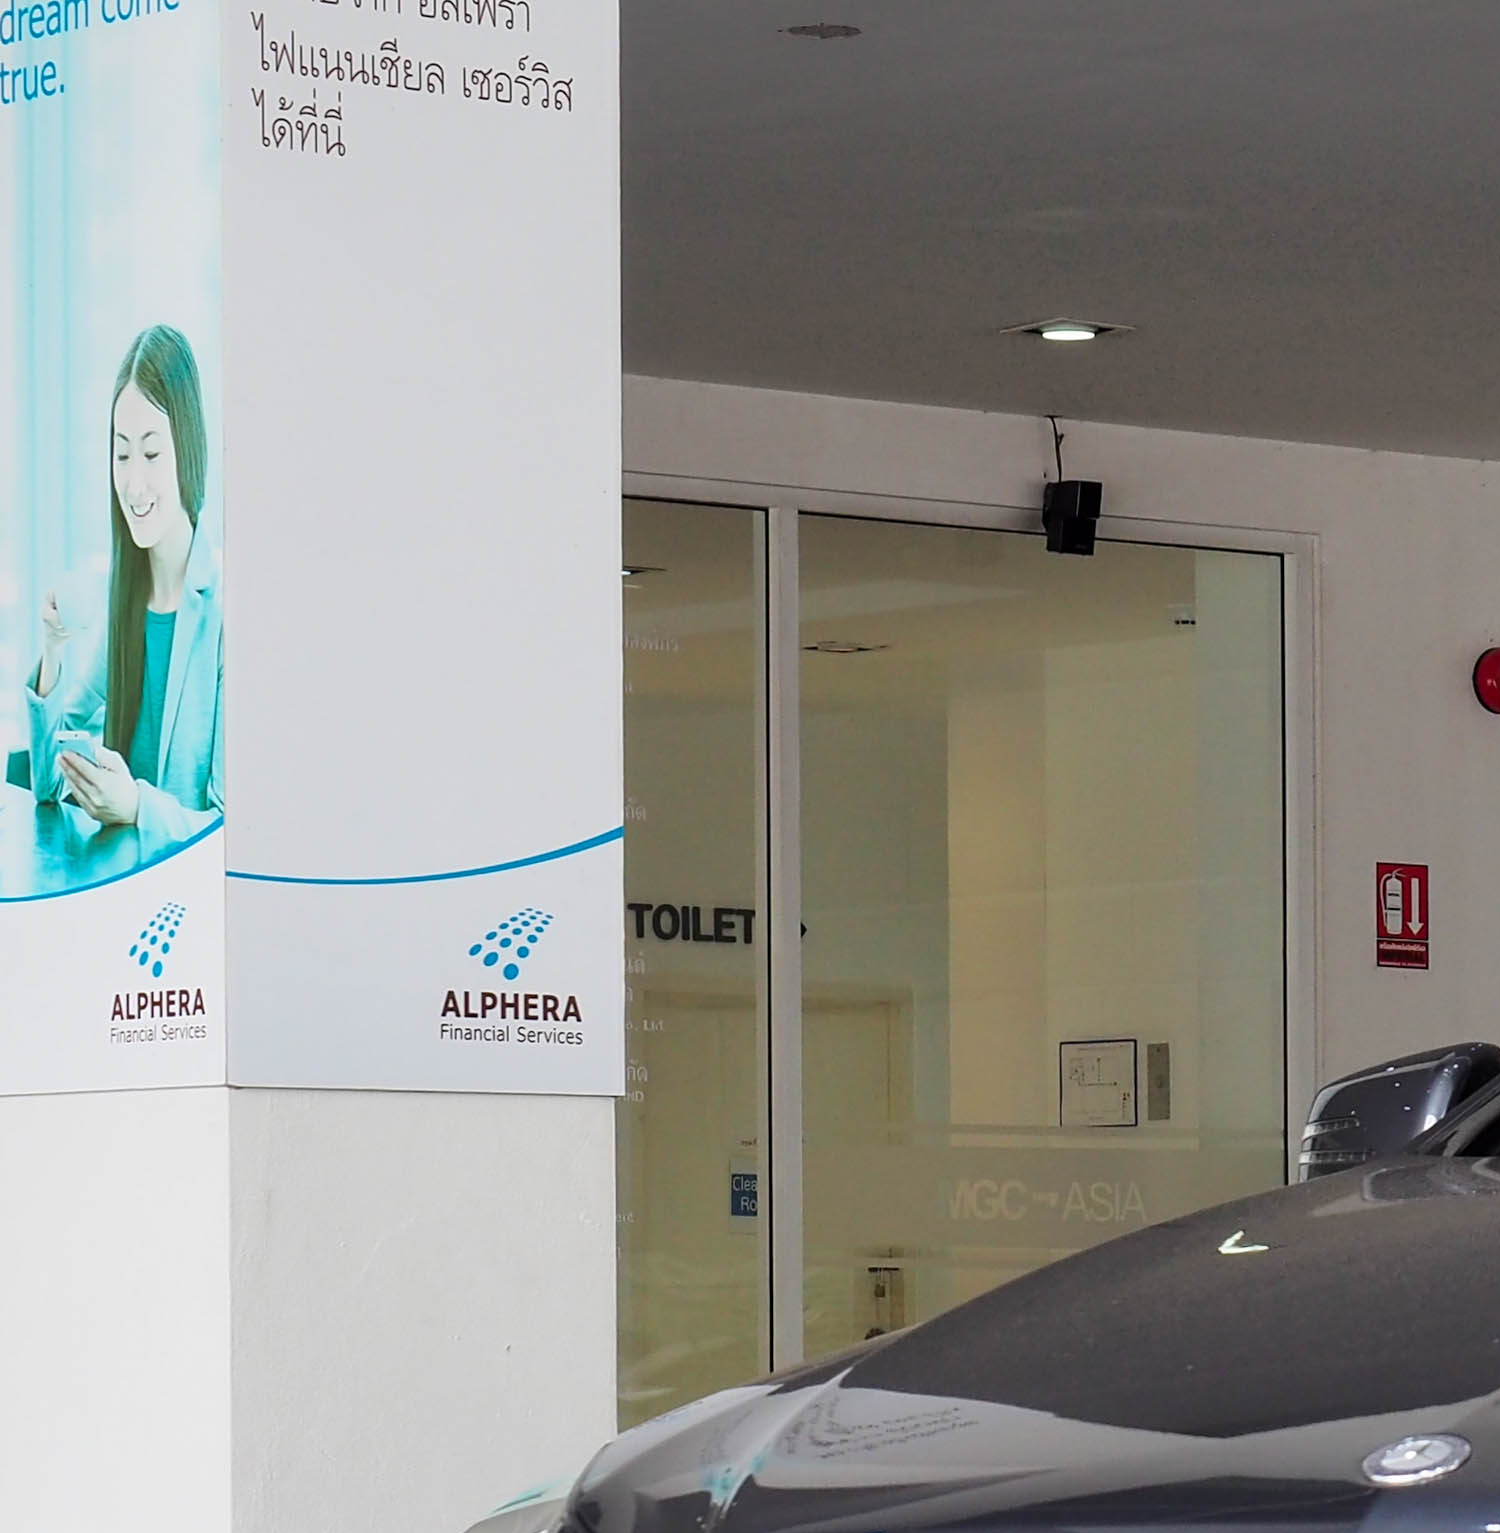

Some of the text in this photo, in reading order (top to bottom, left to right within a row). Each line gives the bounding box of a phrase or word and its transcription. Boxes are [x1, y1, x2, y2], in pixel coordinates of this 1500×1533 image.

[0, 0, 89, 45] dream
[0, 60, 65, 104] true.
[250, 11, 574, 112] ไฟแนนเชียล เซอร์วิส
[250, 87, 347, 157] ได้ที่นี่
[627, 903, 756, 944] TOILET
[111, 988, 206, 1022] ALPHERA
[441, 990, 582, 1023] ALPHERA
[110, 1023, 207, 1045] Financial Services
[440, 1023, 583, 1045] Financial Services
